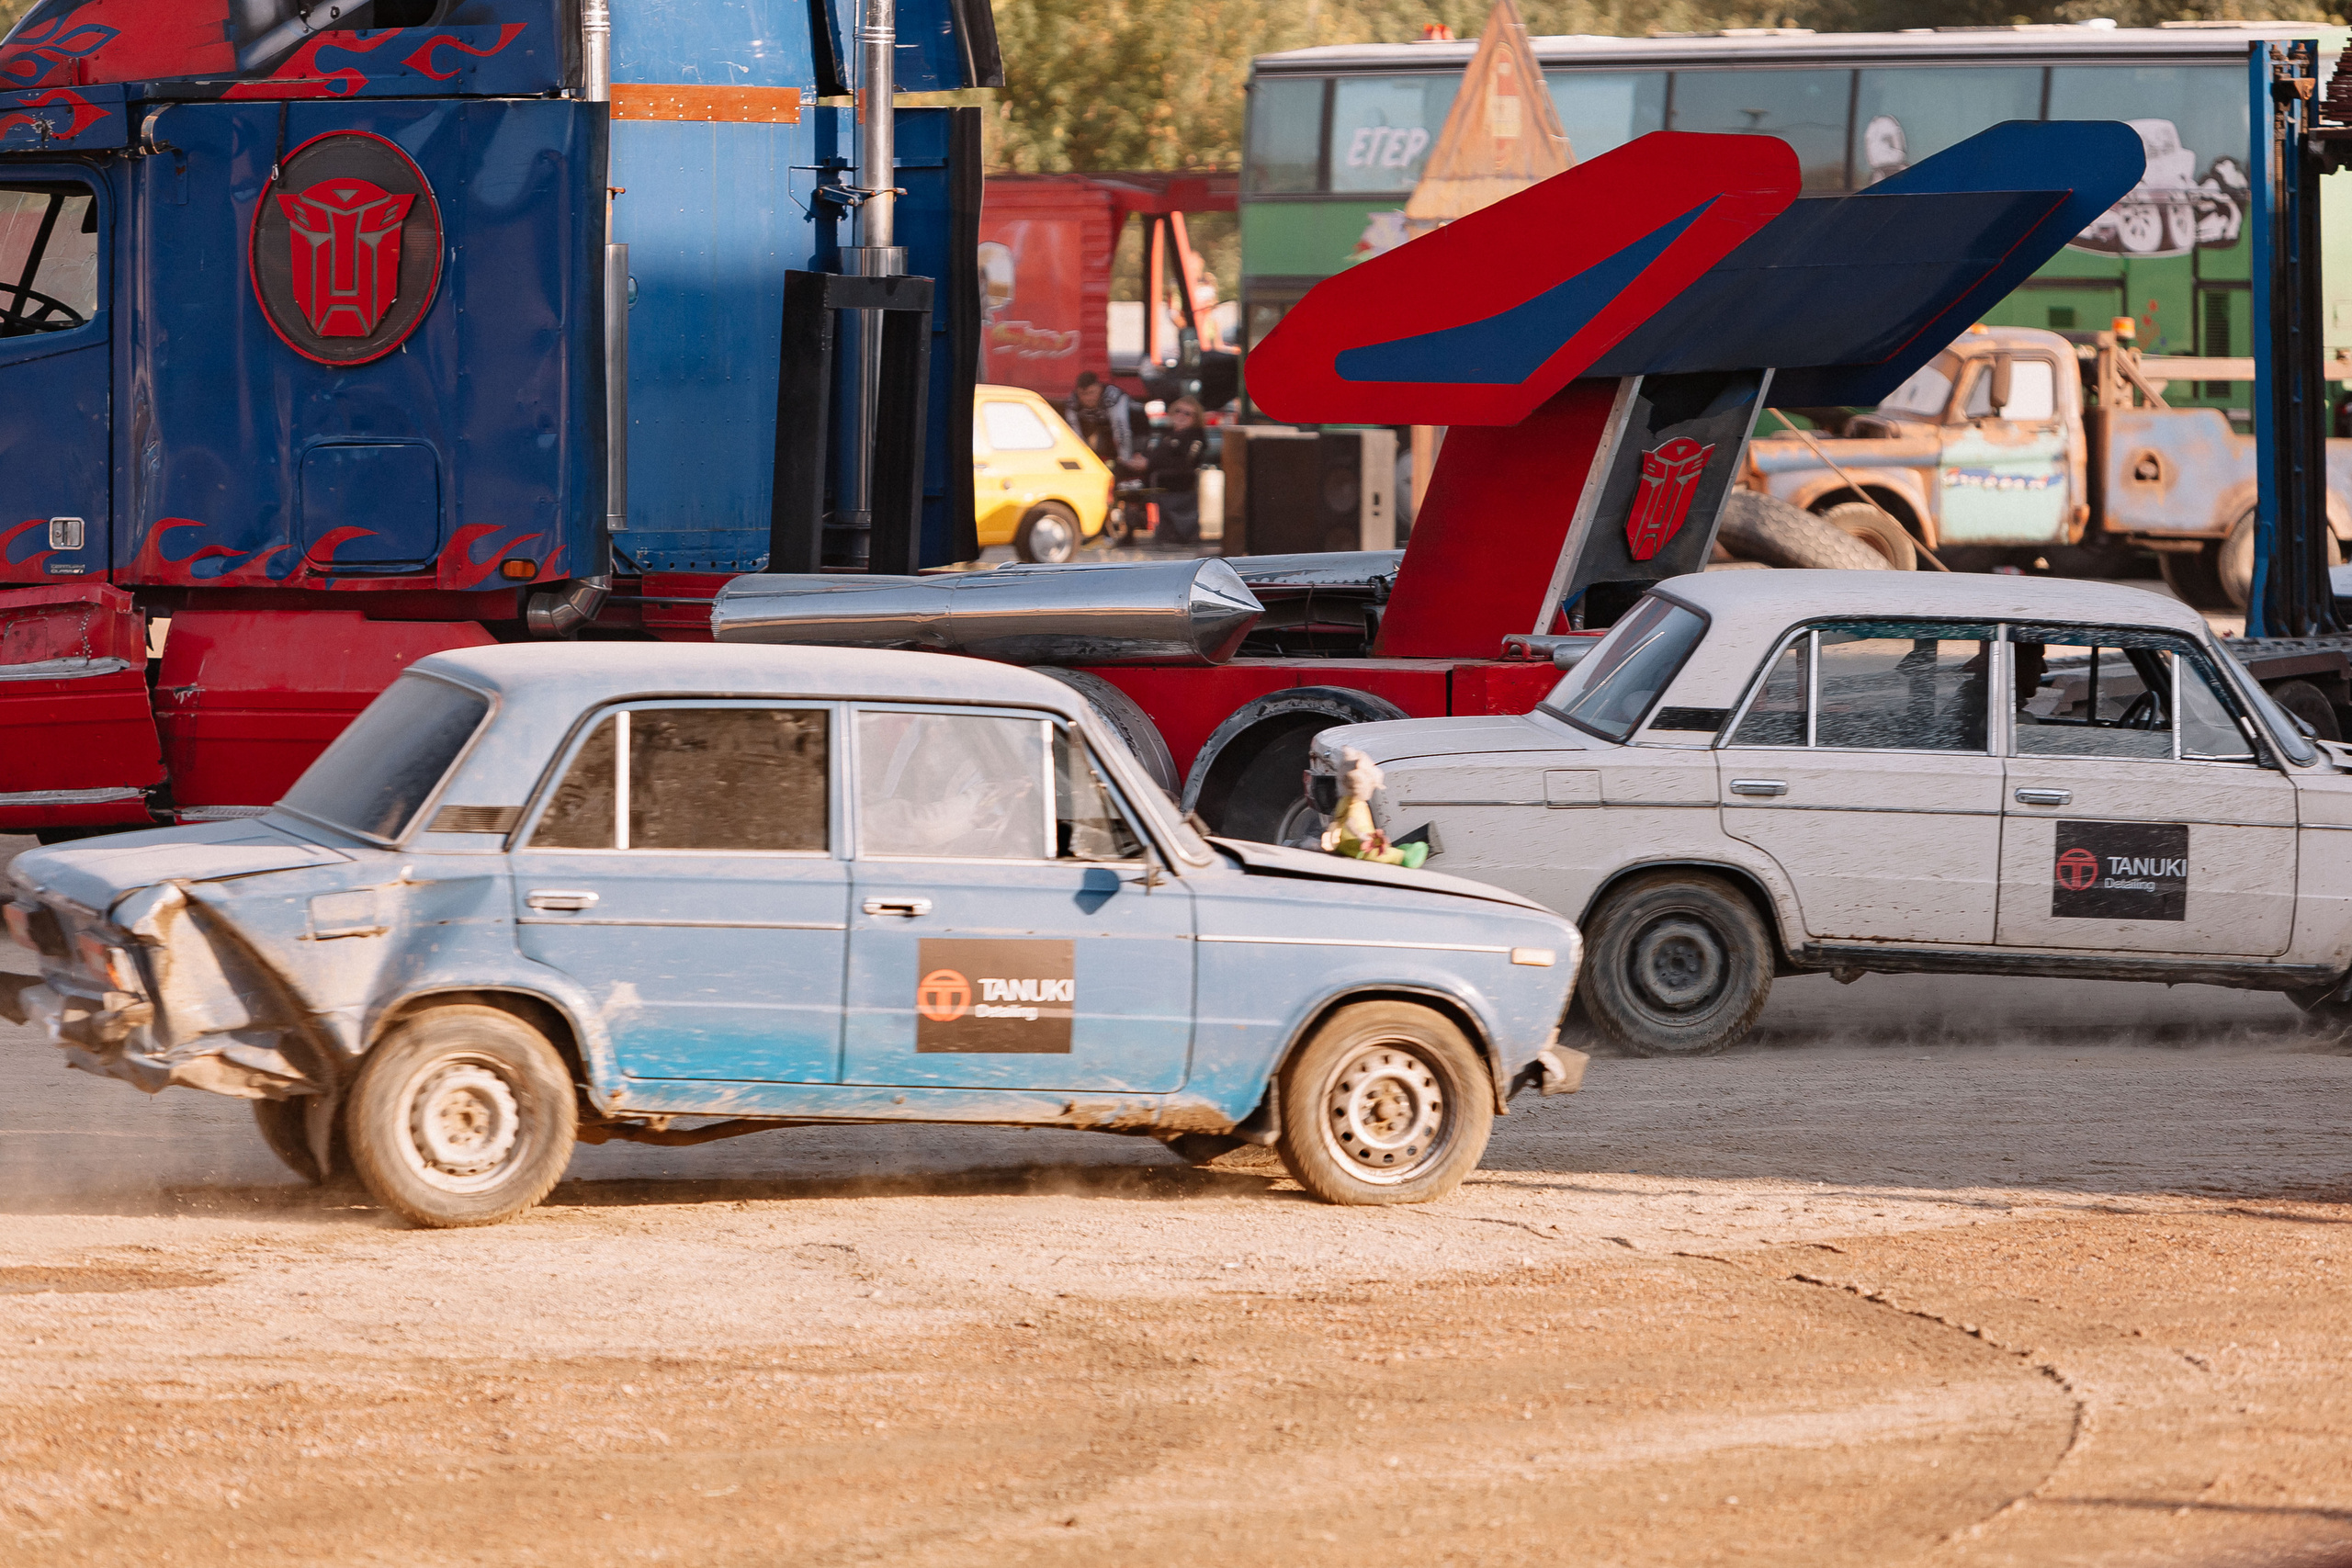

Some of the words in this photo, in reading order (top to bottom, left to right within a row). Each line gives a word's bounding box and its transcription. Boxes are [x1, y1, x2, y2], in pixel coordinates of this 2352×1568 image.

[2107, 856, 2188, 877] TANUKI
[2104, 877, 2155, 893] Detailing
[977, 978, 1075, 1002] TANUKI
